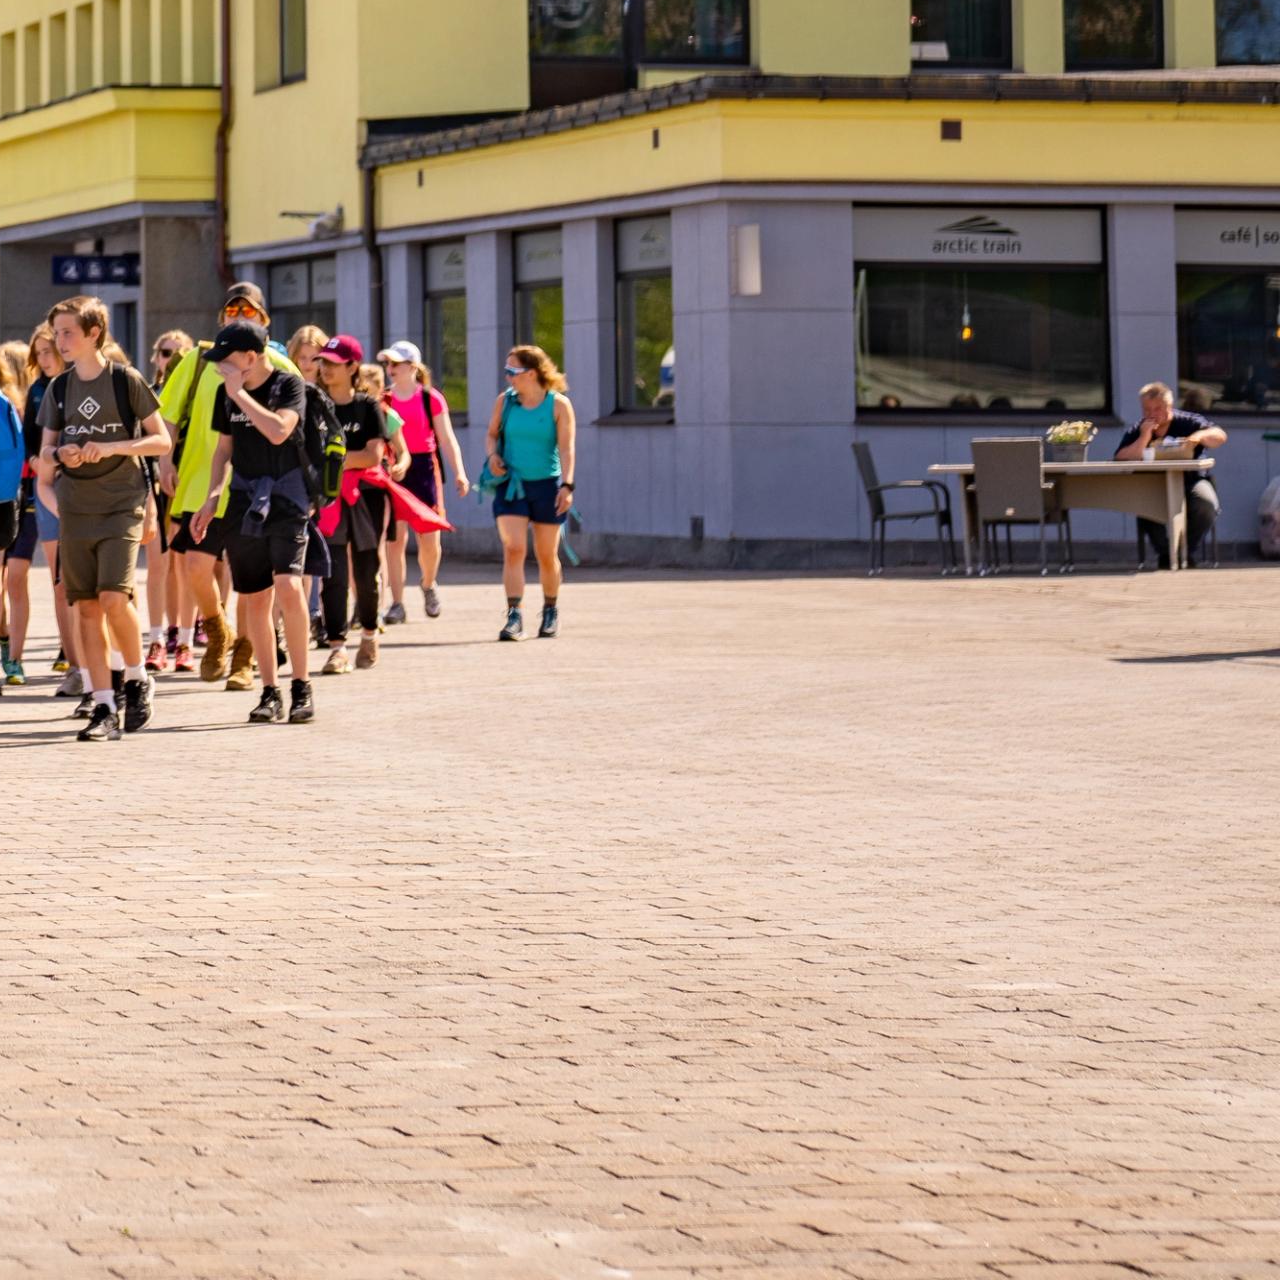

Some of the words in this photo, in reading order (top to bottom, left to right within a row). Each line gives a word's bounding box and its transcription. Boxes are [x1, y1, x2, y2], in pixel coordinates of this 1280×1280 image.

[1220, 226, 1251, 244] café
[932, 237, 978, 254] arctic
[983, 237, 1022, 254] train
[64, 423, 123, 435] GANT
